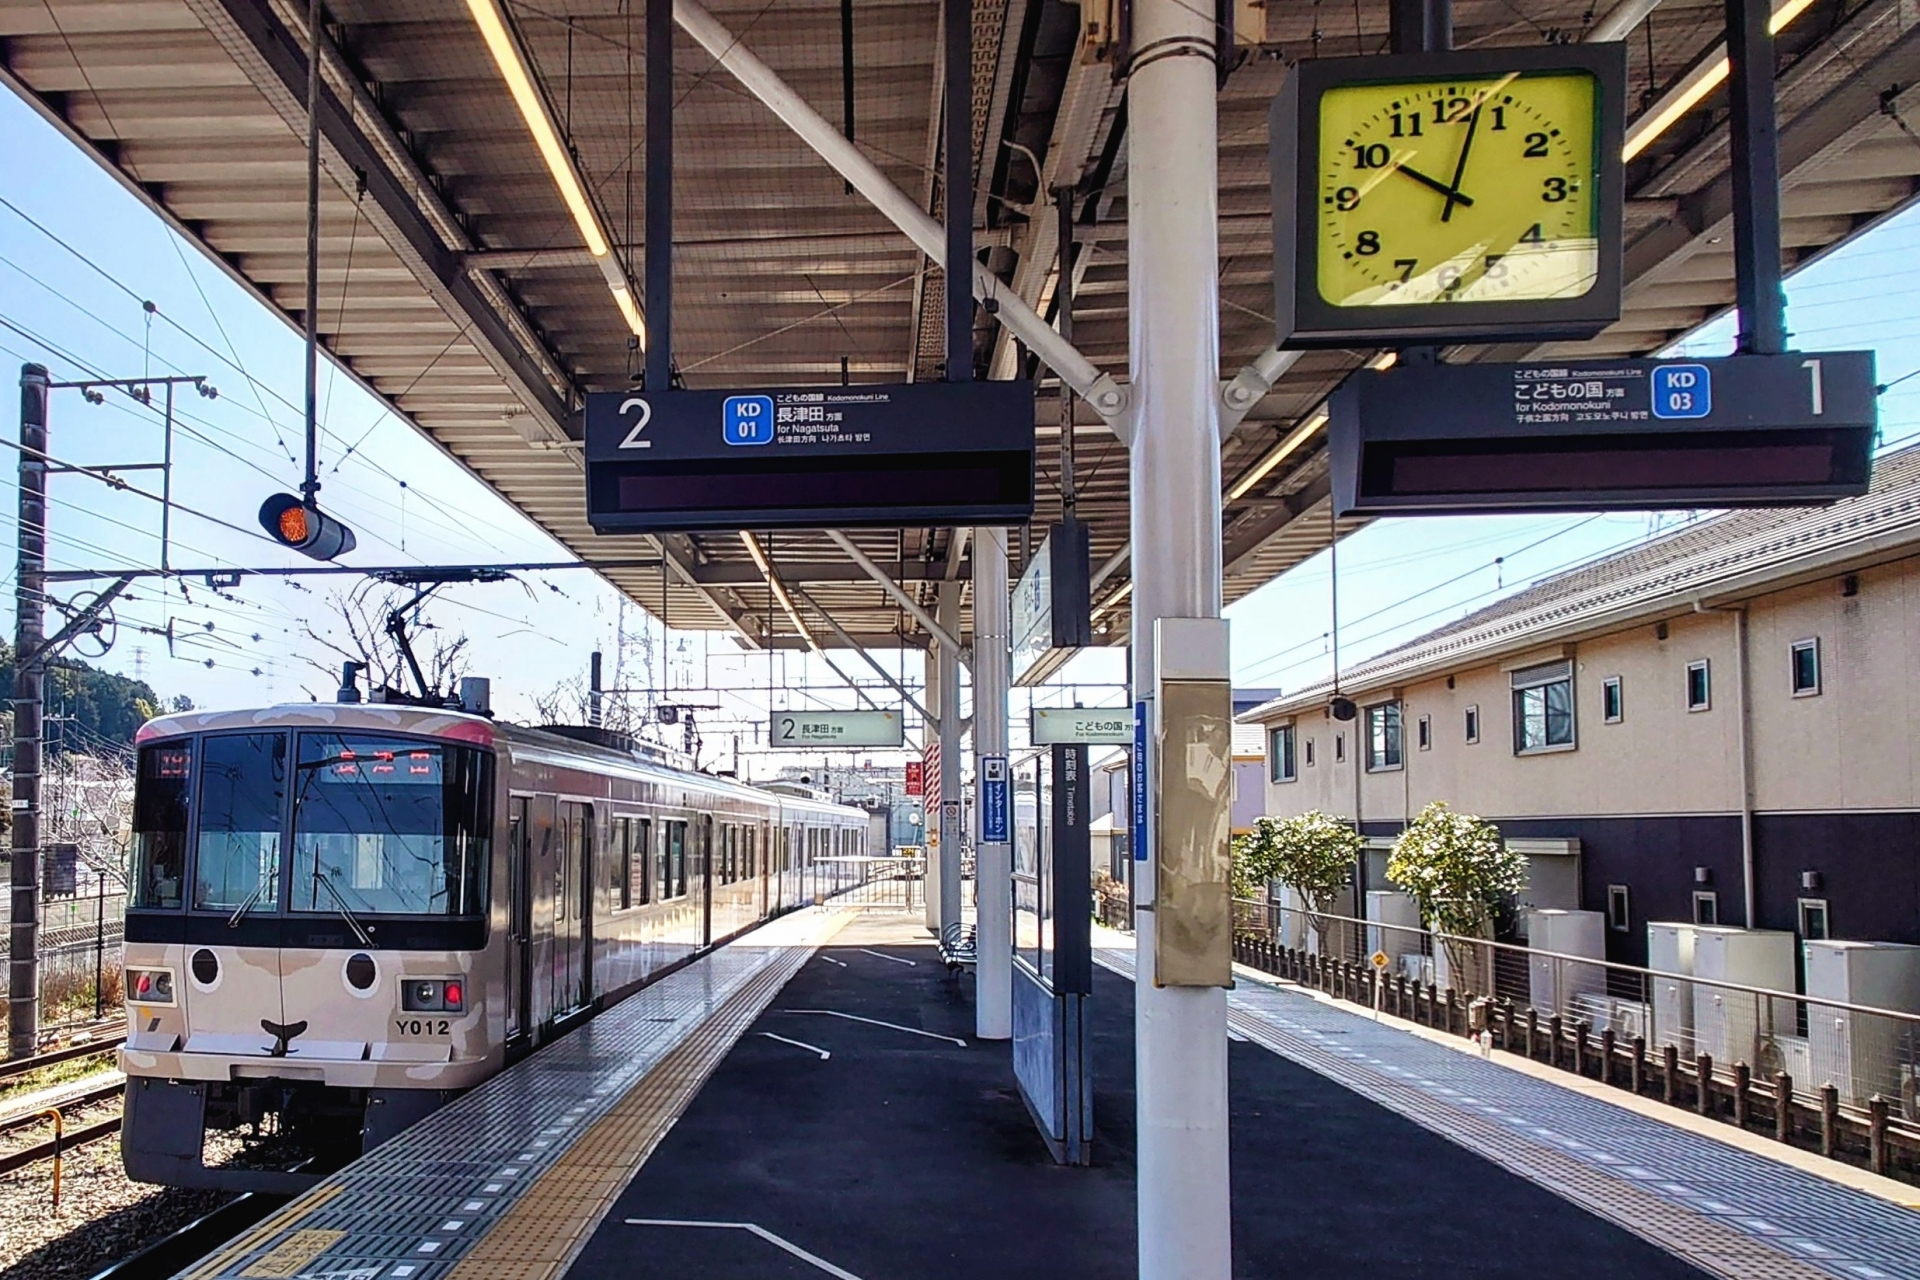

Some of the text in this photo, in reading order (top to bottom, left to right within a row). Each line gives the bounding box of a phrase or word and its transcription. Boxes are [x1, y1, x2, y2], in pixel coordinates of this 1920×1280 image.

[1431, 97, 1472, 124] 12
[1490, 106, 1507, 131] 1
[1389, 113, 1423, 138] 11
[1352, 143, 1391, 169] 10
[1523, 132, 1550, 158] 2
[1335, 187, 1361, 211] 9
[1541, 177, 1568, 202] 3
[1355, 230, 1381, 255] 8
[1518, 223, 1546, 248] 4
[1393, 259, 1418, 284] 7
[1437, 265, 1461, 291] 6
[1484, 254, 1509, 279] 5
[1626, 368, 1642, 376] Line
[1667, 372, 1696, 388] KD
[827, 393, 874, 401] Kodomonokuni
[1514, 381, 1603, 399] こどもの国
[1801, 359, 1823, 415] 1
[736, 403, 761, 418] KD
[1515, 401, 1611, 412] for Kodomonokuni
[1669, 392, 1692, 410] 03
[618, 398, 652, 449] 2
[776, 406, 824, 422] 長津田
[738, 421, 757, 438] 01
[777, 424, 839, 435] for Nagatsuta
[781, 718, 795, 740] 2
[802, 724, 829, 734] 長津田
[1075, 721, 1123, 731] こどもの国
[995, 782, 1003, 833] インターホン
[1067, 786, 1075, 826] Timetable
[1376, 954, 1384, 965] 2
[396, 1020, 450, 1036] Y012
